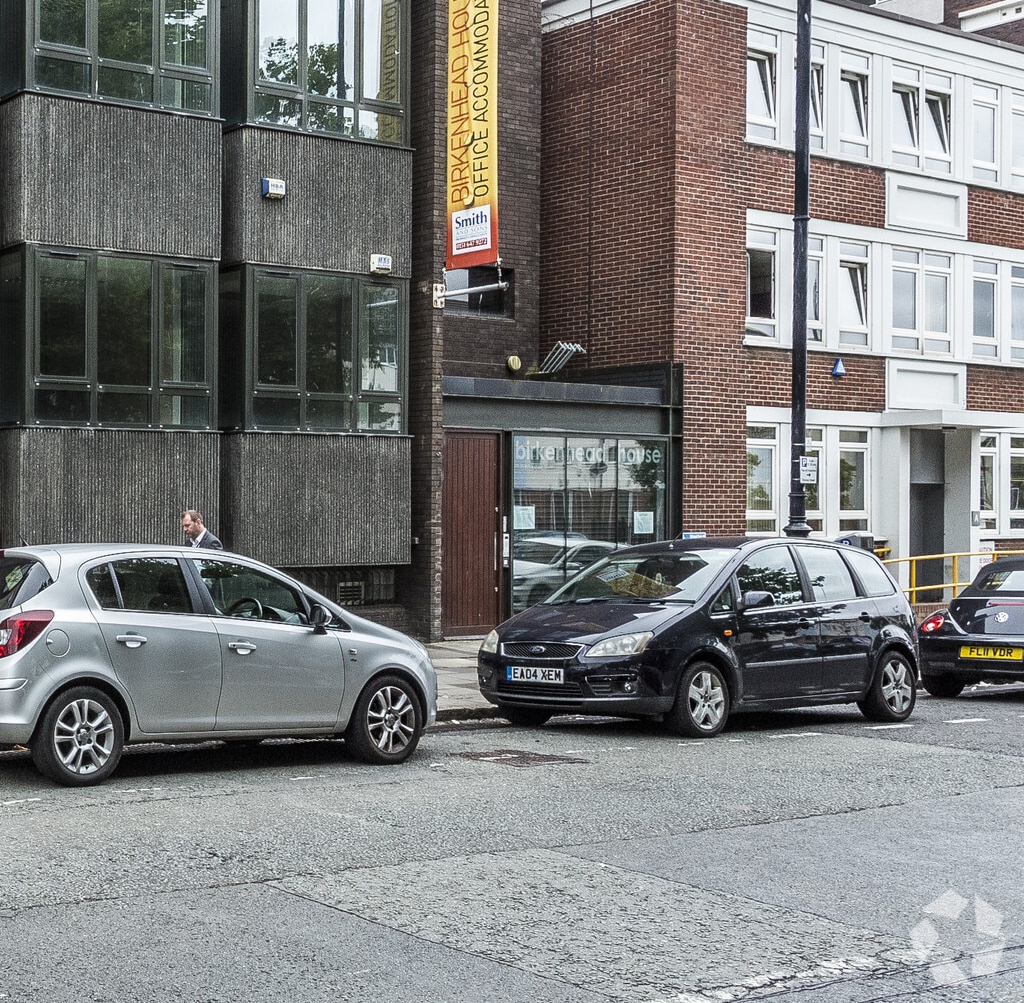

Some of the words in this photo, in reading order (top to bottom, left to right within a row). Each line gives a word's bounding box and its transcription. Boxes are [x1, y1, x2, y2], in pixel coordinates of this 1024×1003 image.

[451, 54, 470, 203] BIRKENHEAD
[472, 128, 489, 198] OFFICE
[455, 210, 488, 230] Smith
[514, 439, 606, 463] birkenhead
[618, 443, 662, 465] house
[969, 647, 989, 656] FL11
[992, 648, 1013, 657] VDR
[513, 668, 538, 679] EA04
[540, 669, 561, 681] XEM
